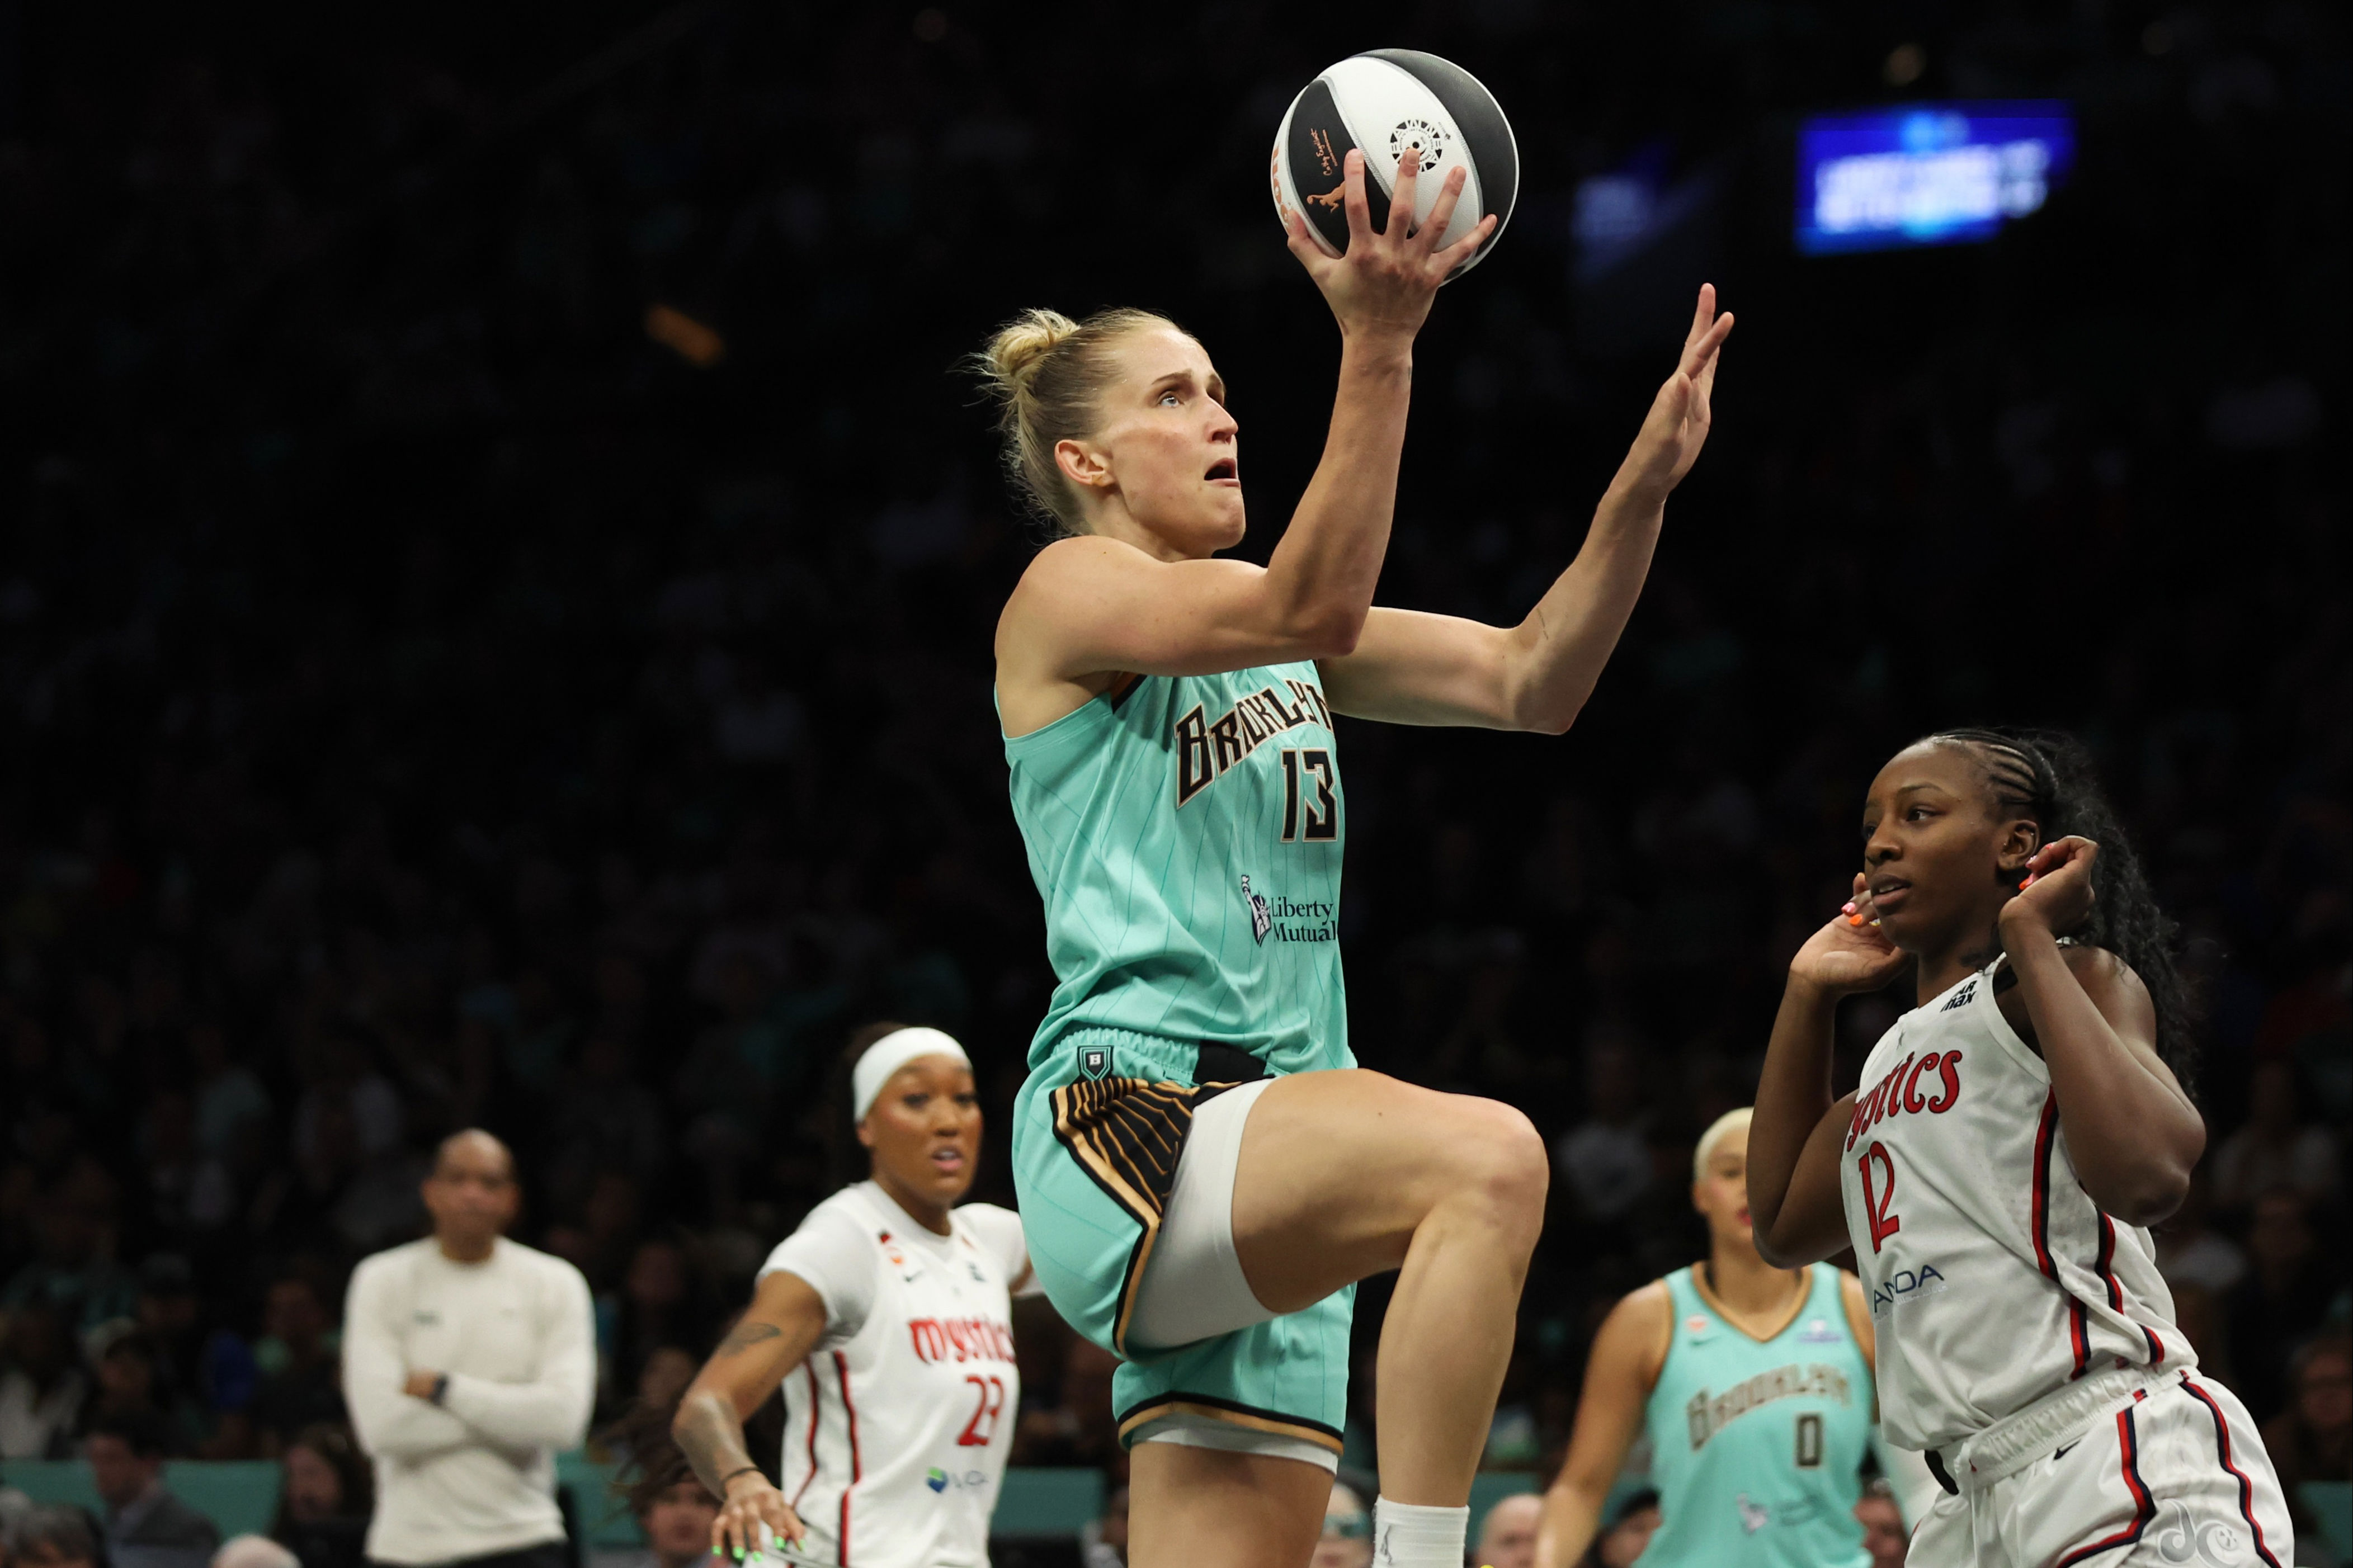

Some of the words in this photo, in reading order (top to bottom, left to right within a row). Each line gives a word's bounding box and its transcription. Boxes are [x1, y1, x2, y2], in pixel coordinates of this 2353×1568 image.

[1281, 748, 1337, 843] 13
[1271, 896, 1334, 925] Liberty
[1274, 920, 1337, 943] Mutual
[1847, 1050, 1963, 1152] ystics
[1858, 1141, 1900, 1254] 12
[1874, 1265, 1945, 1314] ANDA
[957, 1375, 1005, 1446] 23
[1795, 1412, 1824, 1470] 0
